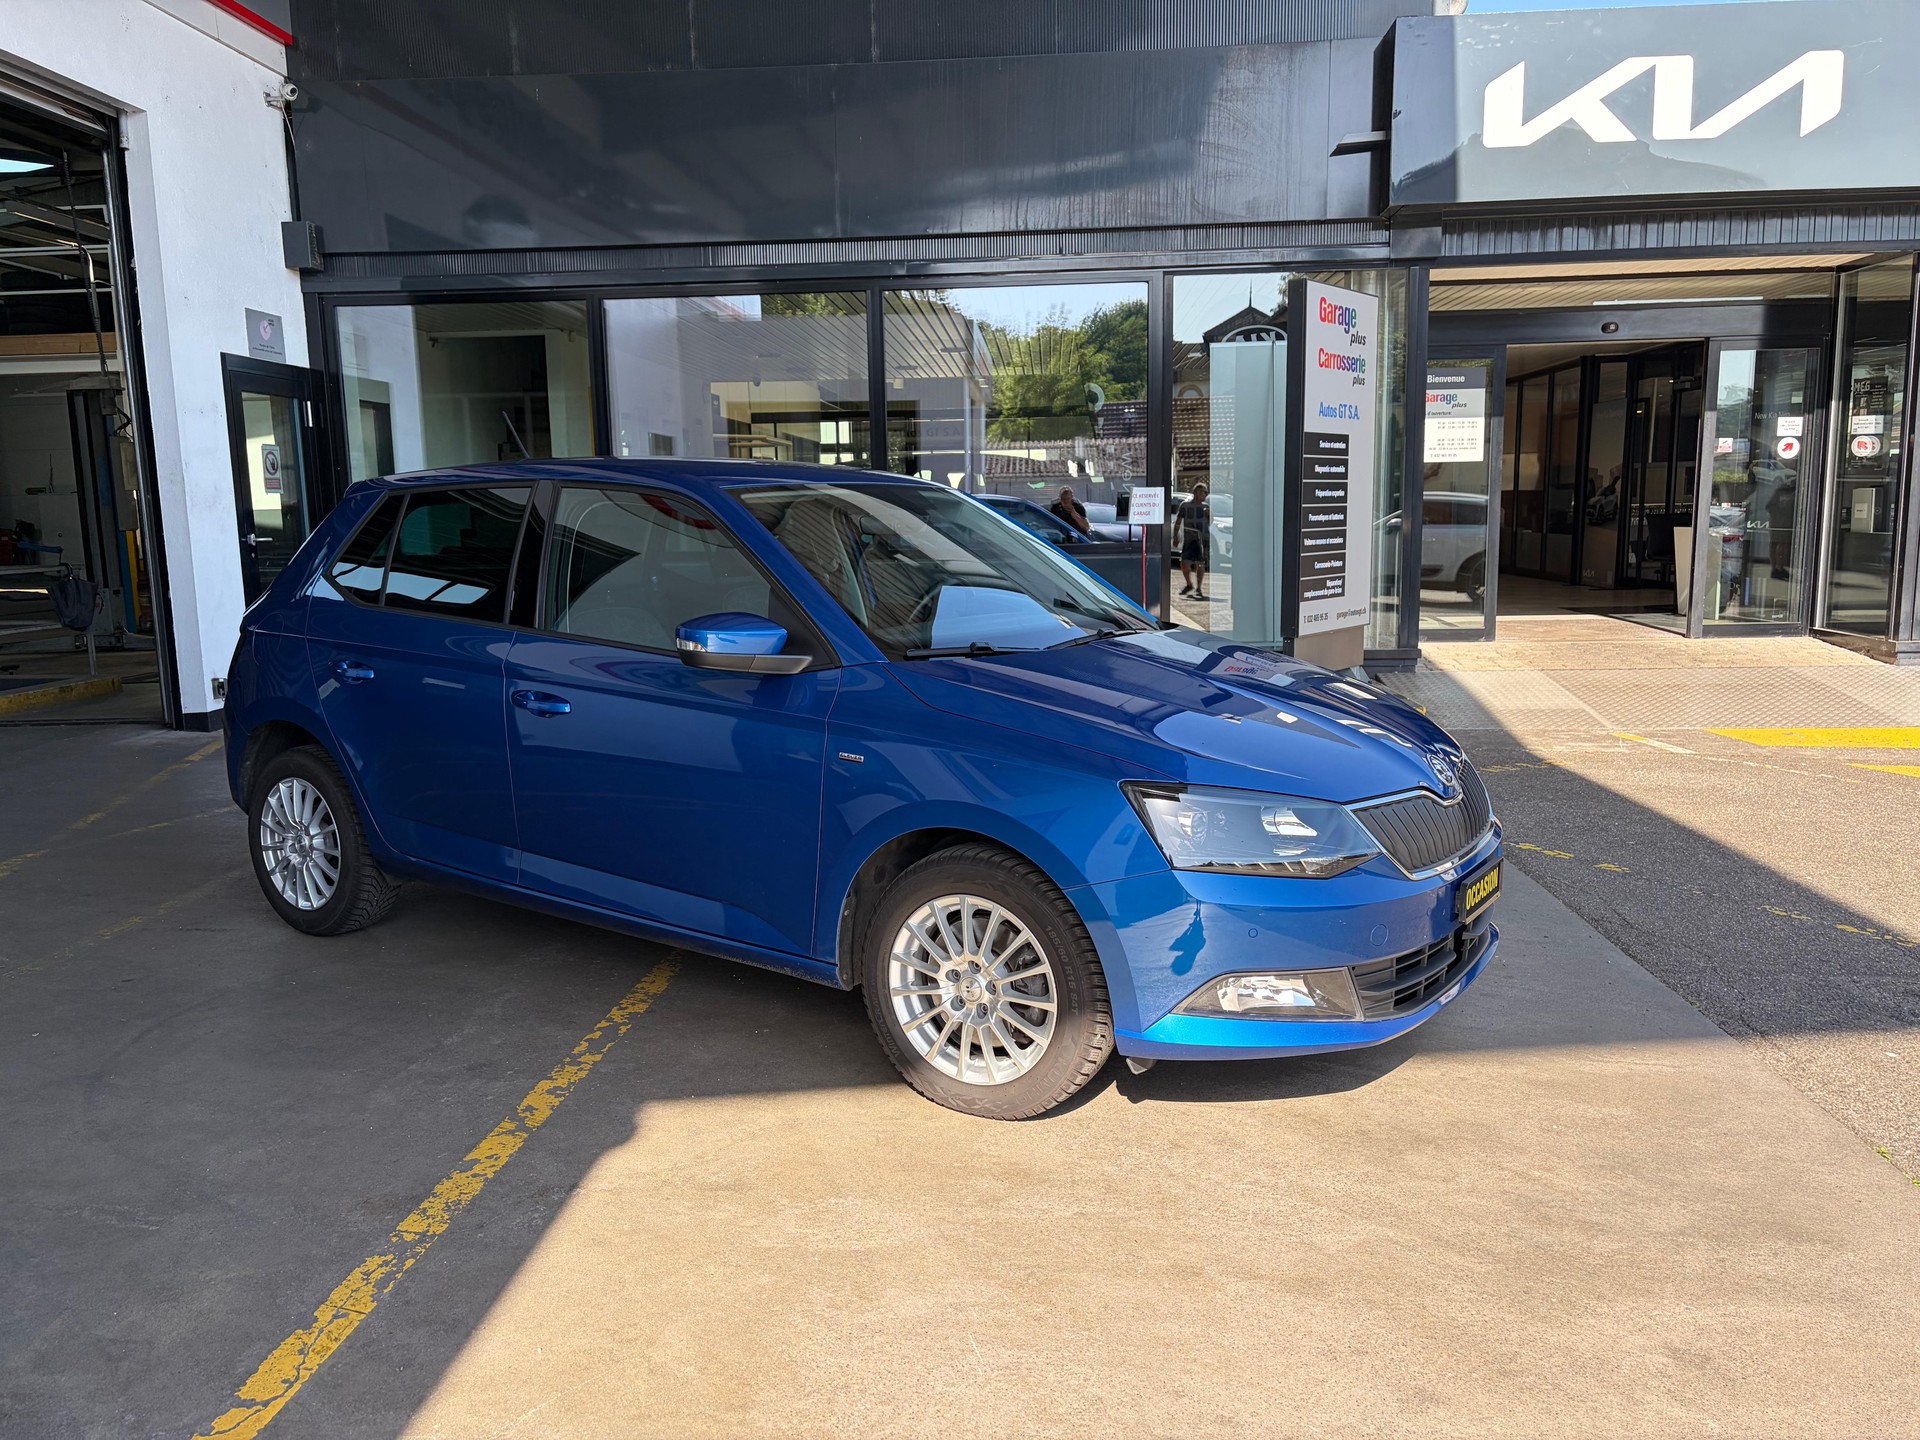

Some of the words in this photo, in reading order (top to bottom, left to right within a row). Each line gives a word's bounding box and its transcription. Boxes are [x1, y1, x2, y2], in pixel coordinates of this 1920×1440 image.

[1482, 49, 1845, 149] KIA
[1319, 296, 1357, 334] Garage
[1349, 331, 1367, 346] plus
[1318, 347, 1366, 374] Carrosserie
[1352, 374, 1366, 387] plus
[1426, 374, 1466, 383] Bienvenue
[1424, 392, 1458, 405] Garage
[1319, 401, 1338, 419] Autos
[1338, 403, 1349, 419] GT
[1348, 404, 1360, 420] S.A.
[1466, 866, 1499, 910] OCCASION
[1045, 925, 1068, 963] 185/60
